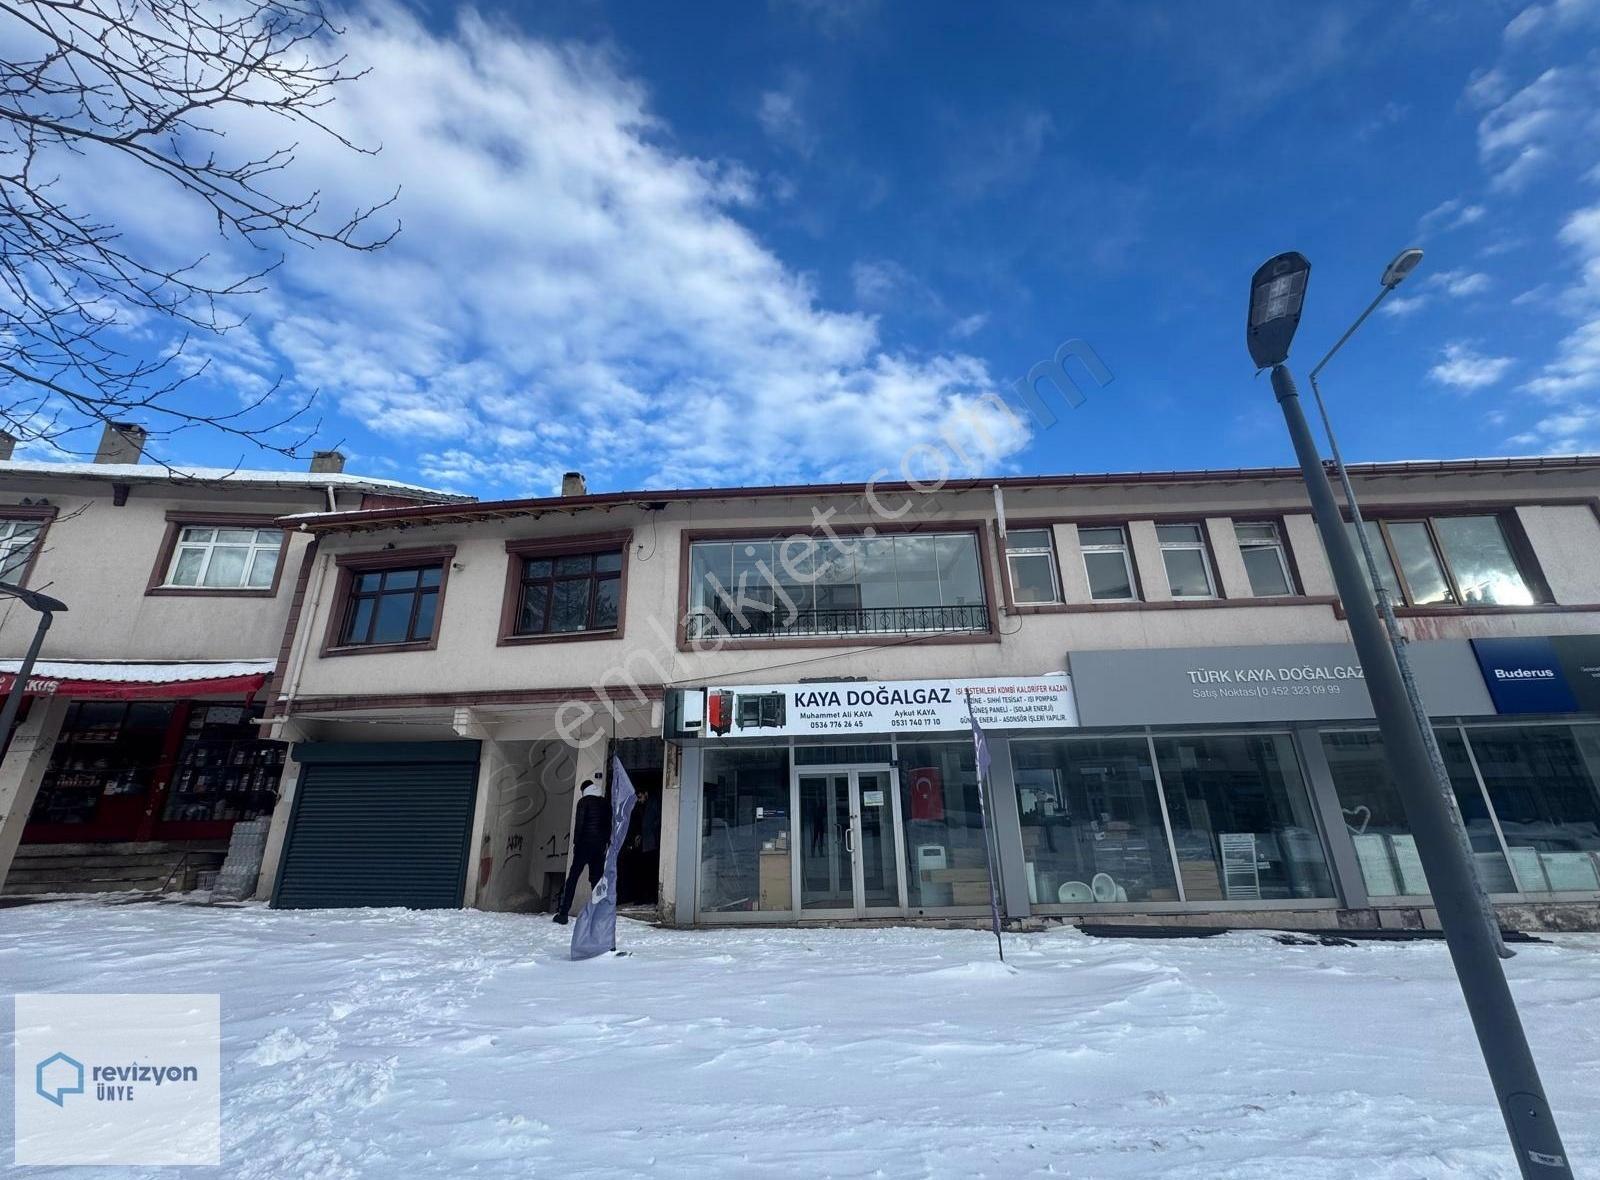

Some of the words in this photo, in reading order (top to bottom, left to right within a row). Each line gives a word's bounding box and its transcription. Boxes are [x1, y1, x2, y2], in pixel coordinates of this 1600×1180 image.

[1187, 668, 1232, 683] TÜRK
[1234, 669, 1276, 682] KAYA
[1278, 664, 1365, 681] DOĞALGAZ
[1495, 669, 1554, 678] Buderus
[1049, 684, 1067, 692] KAZAN
[1192, 688, 1218, 699] Satış
[1271, 686, 1289, 696] 452
[1291, 685, 1311, 695] 323
[1312, 685, 1326, 694] 09
[1327, 685, 1341, 694] 99
[795, 691, 841, 708] KAYA
[847, 686, 952, 706] DOĞALGAZ
[800, 711, 840, 719] Muhammet
[842, 710, 852, 718] Ali
[854, 710, 873, 718] KAYA
[894, 709, 916, 718] Aykut
[810, 721, 828, 729] 0536
[829, 720, 842, 729] 776
[844, 720, 853, 728] 26
[854, 720, 864, 728] 45
[891, 719, 908, 727] 0531
[924, 718, 931, 726] 17
[933, 718, 941, 726] 10
